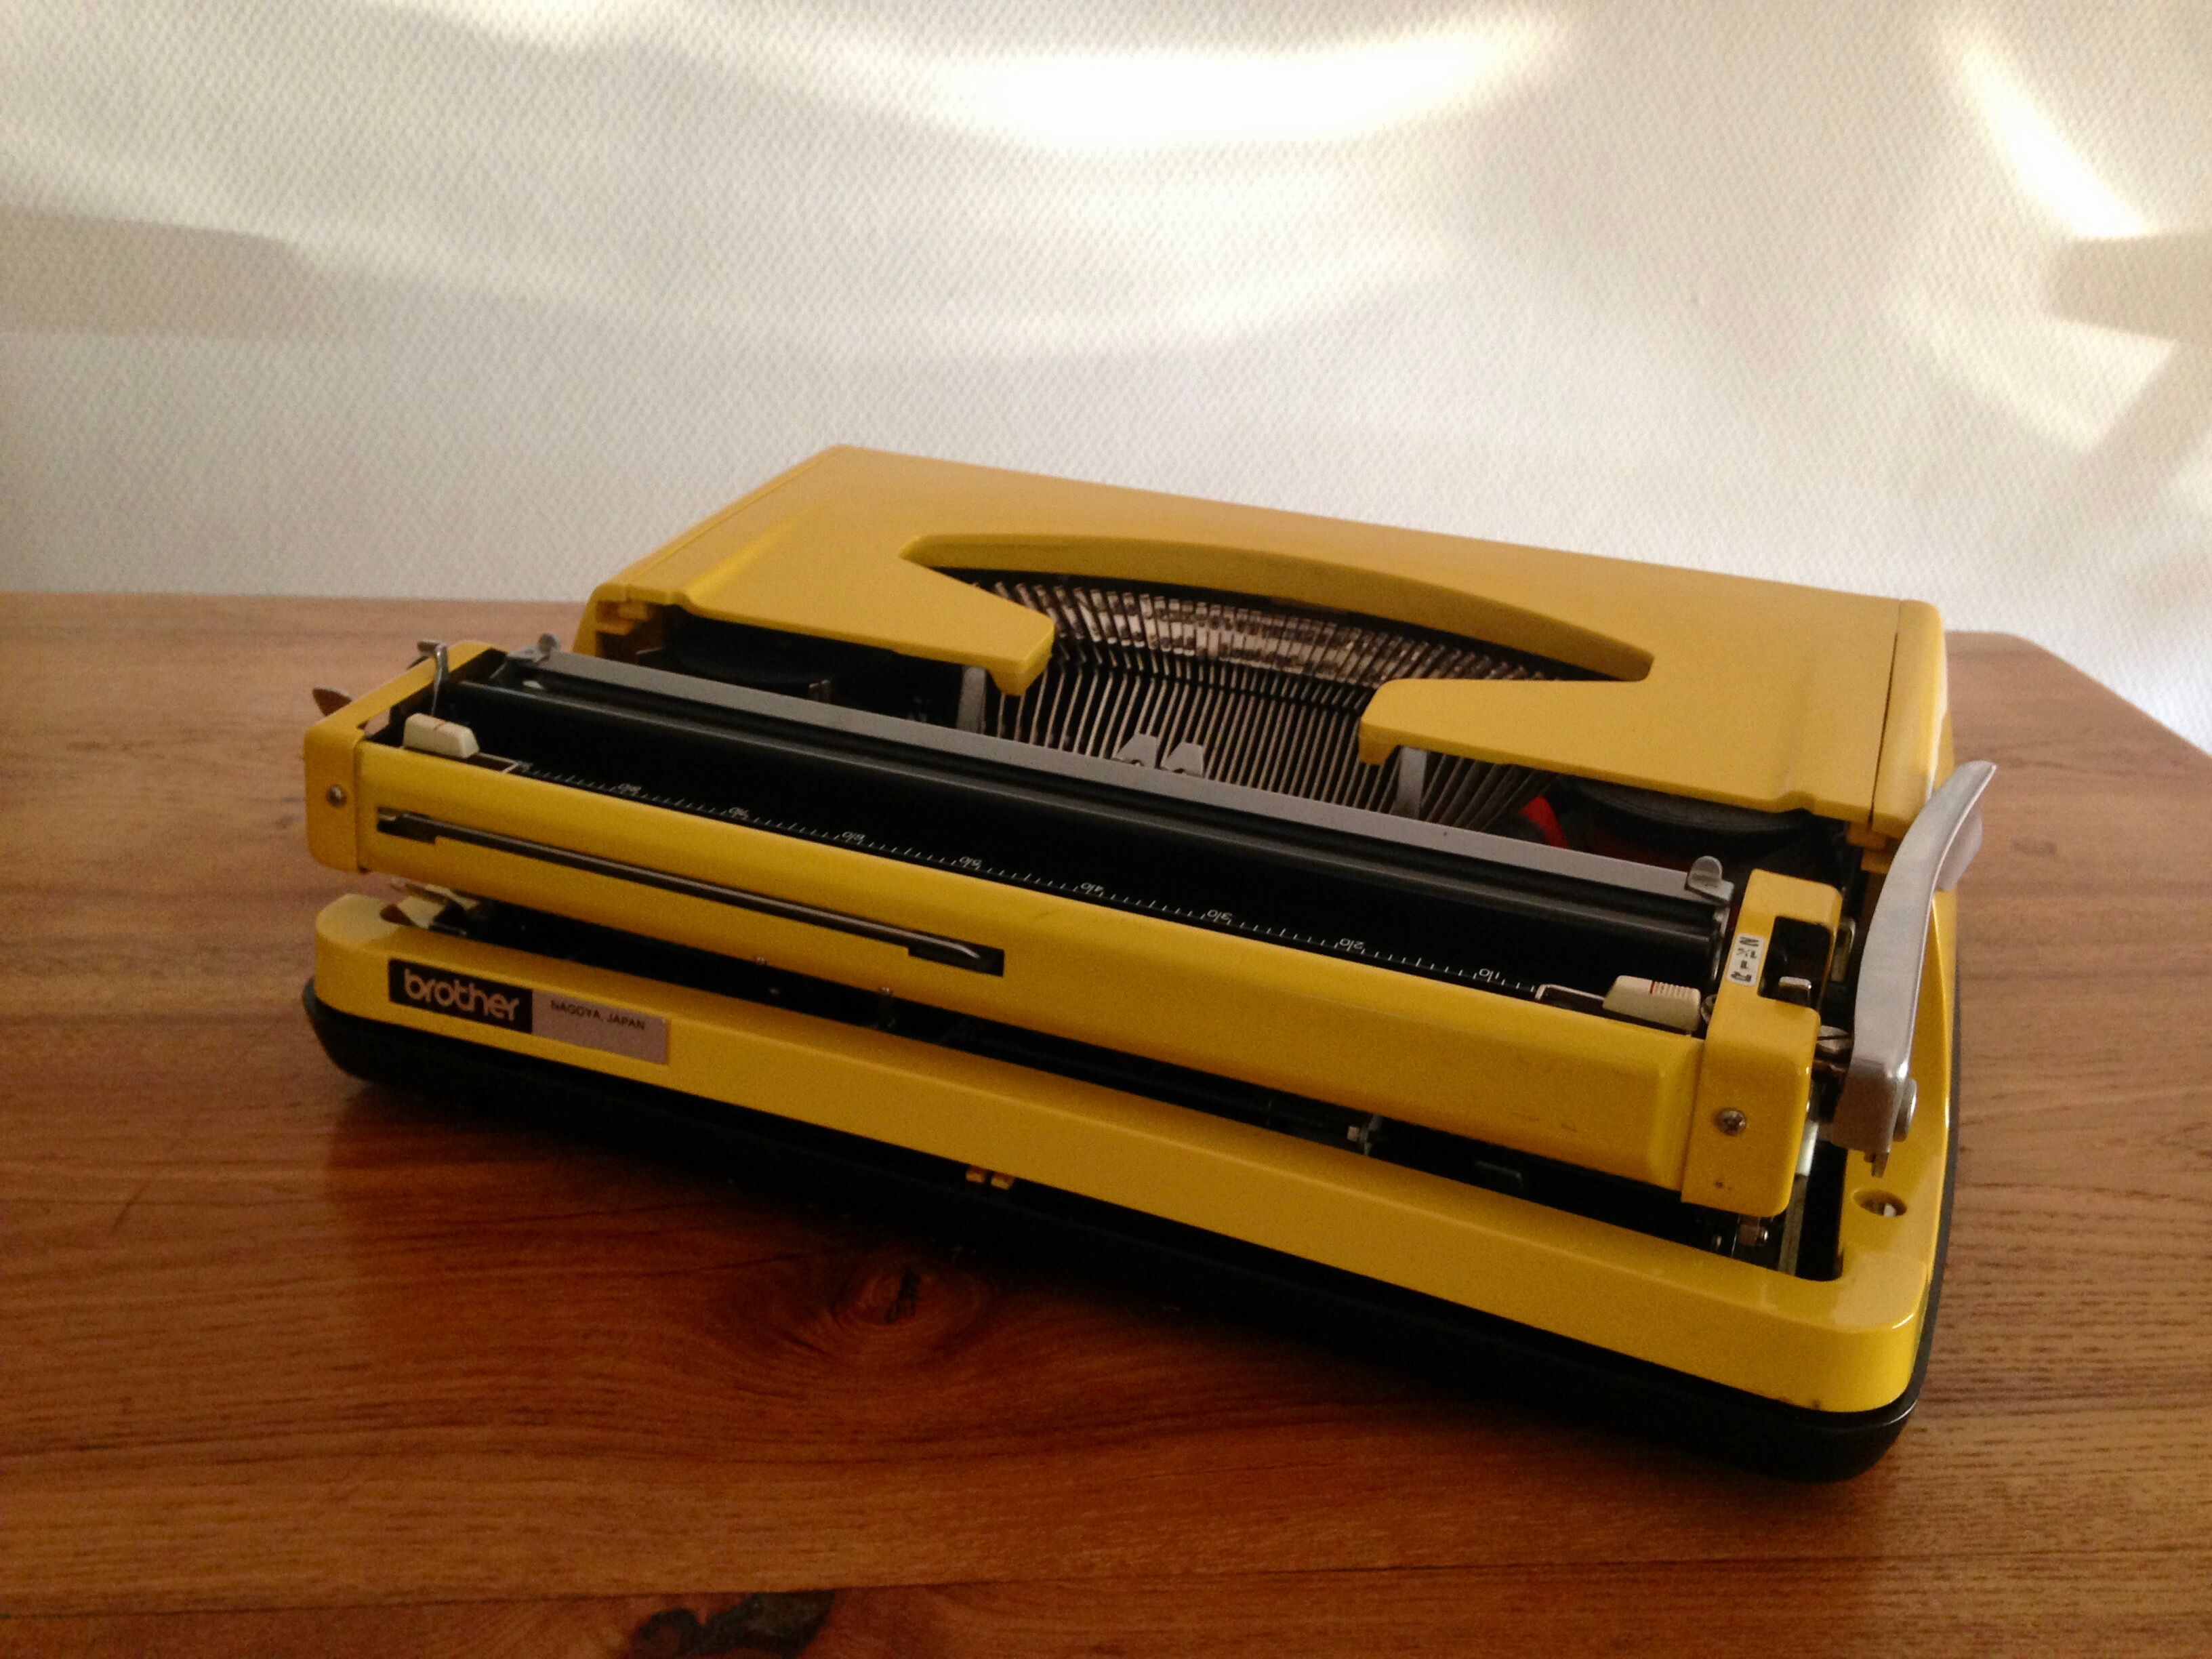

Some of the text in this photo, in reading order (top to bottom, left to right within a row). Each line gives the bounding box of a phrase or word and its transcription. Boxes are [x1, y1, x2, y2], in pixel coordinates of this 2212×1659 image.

[1207, 909, 1232, 920] 30
[1339, 938, 1364, 949] 20
[403, 968, 520, 1022] brother
[550, 999, 646, 1031] NAGOYA, JAPAN
